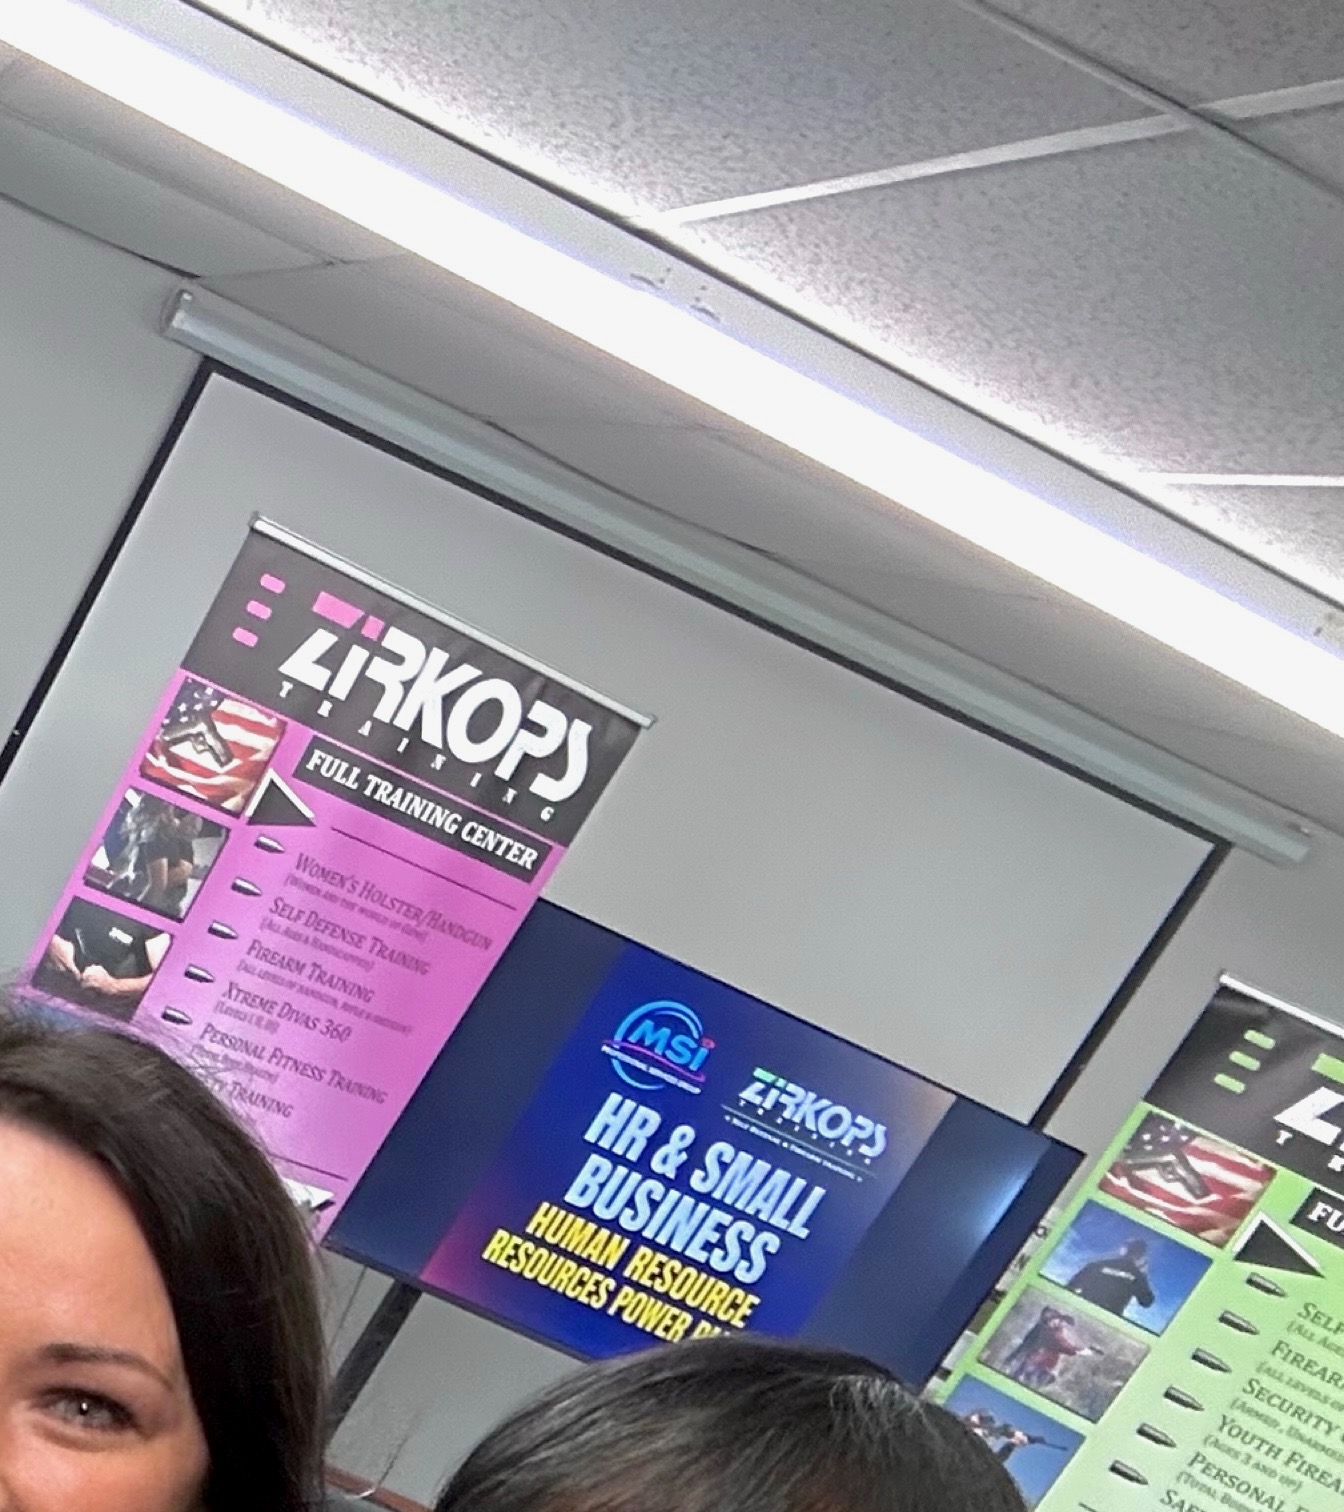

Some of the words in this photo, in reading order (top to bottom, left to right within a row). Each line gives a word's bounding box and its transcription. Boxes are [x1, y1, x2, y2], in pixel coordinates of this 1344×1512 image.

[278, 592, 592, 802] ZIRKOPS
[307, 750, 363, 789] FULL
[362, 775, 461, 834] TRAINING
[460, 820, 538, 869] CENTER
[201, 1023, 267, 1062] PERSONAL
[268, 1047, 326, 1082] FITNESS
[224, 981, 276, 1016] XTREME
[278, 1002, 319, 1031] DIVAS
[322, 1018, 351, 1043] 360
[739, 1067, 888, 1159] ZIRKOPS
[583, 1092, 662, 1162] HR
[651, 1124, 696, 1180] &
[689, 1140, 827, 1239] SMALL
[524, 1202, 624, 1275] HUMAN
[623, 1245, 762, 1329] RESOURCE
[564, 1153, 780, 1285] BUSINESS
[481, 1227, 617, 1310] RESOURCES
[607, 1285, 695, 1343] POWER
[1242, 1376, 1340, 1438] SECURITY
[1271, 1339, 1344, 1390] FIREAR
[1215, 1414, 1283, 1460] YOUTH
[1286, 1452, 1344, 1494] FIREA
